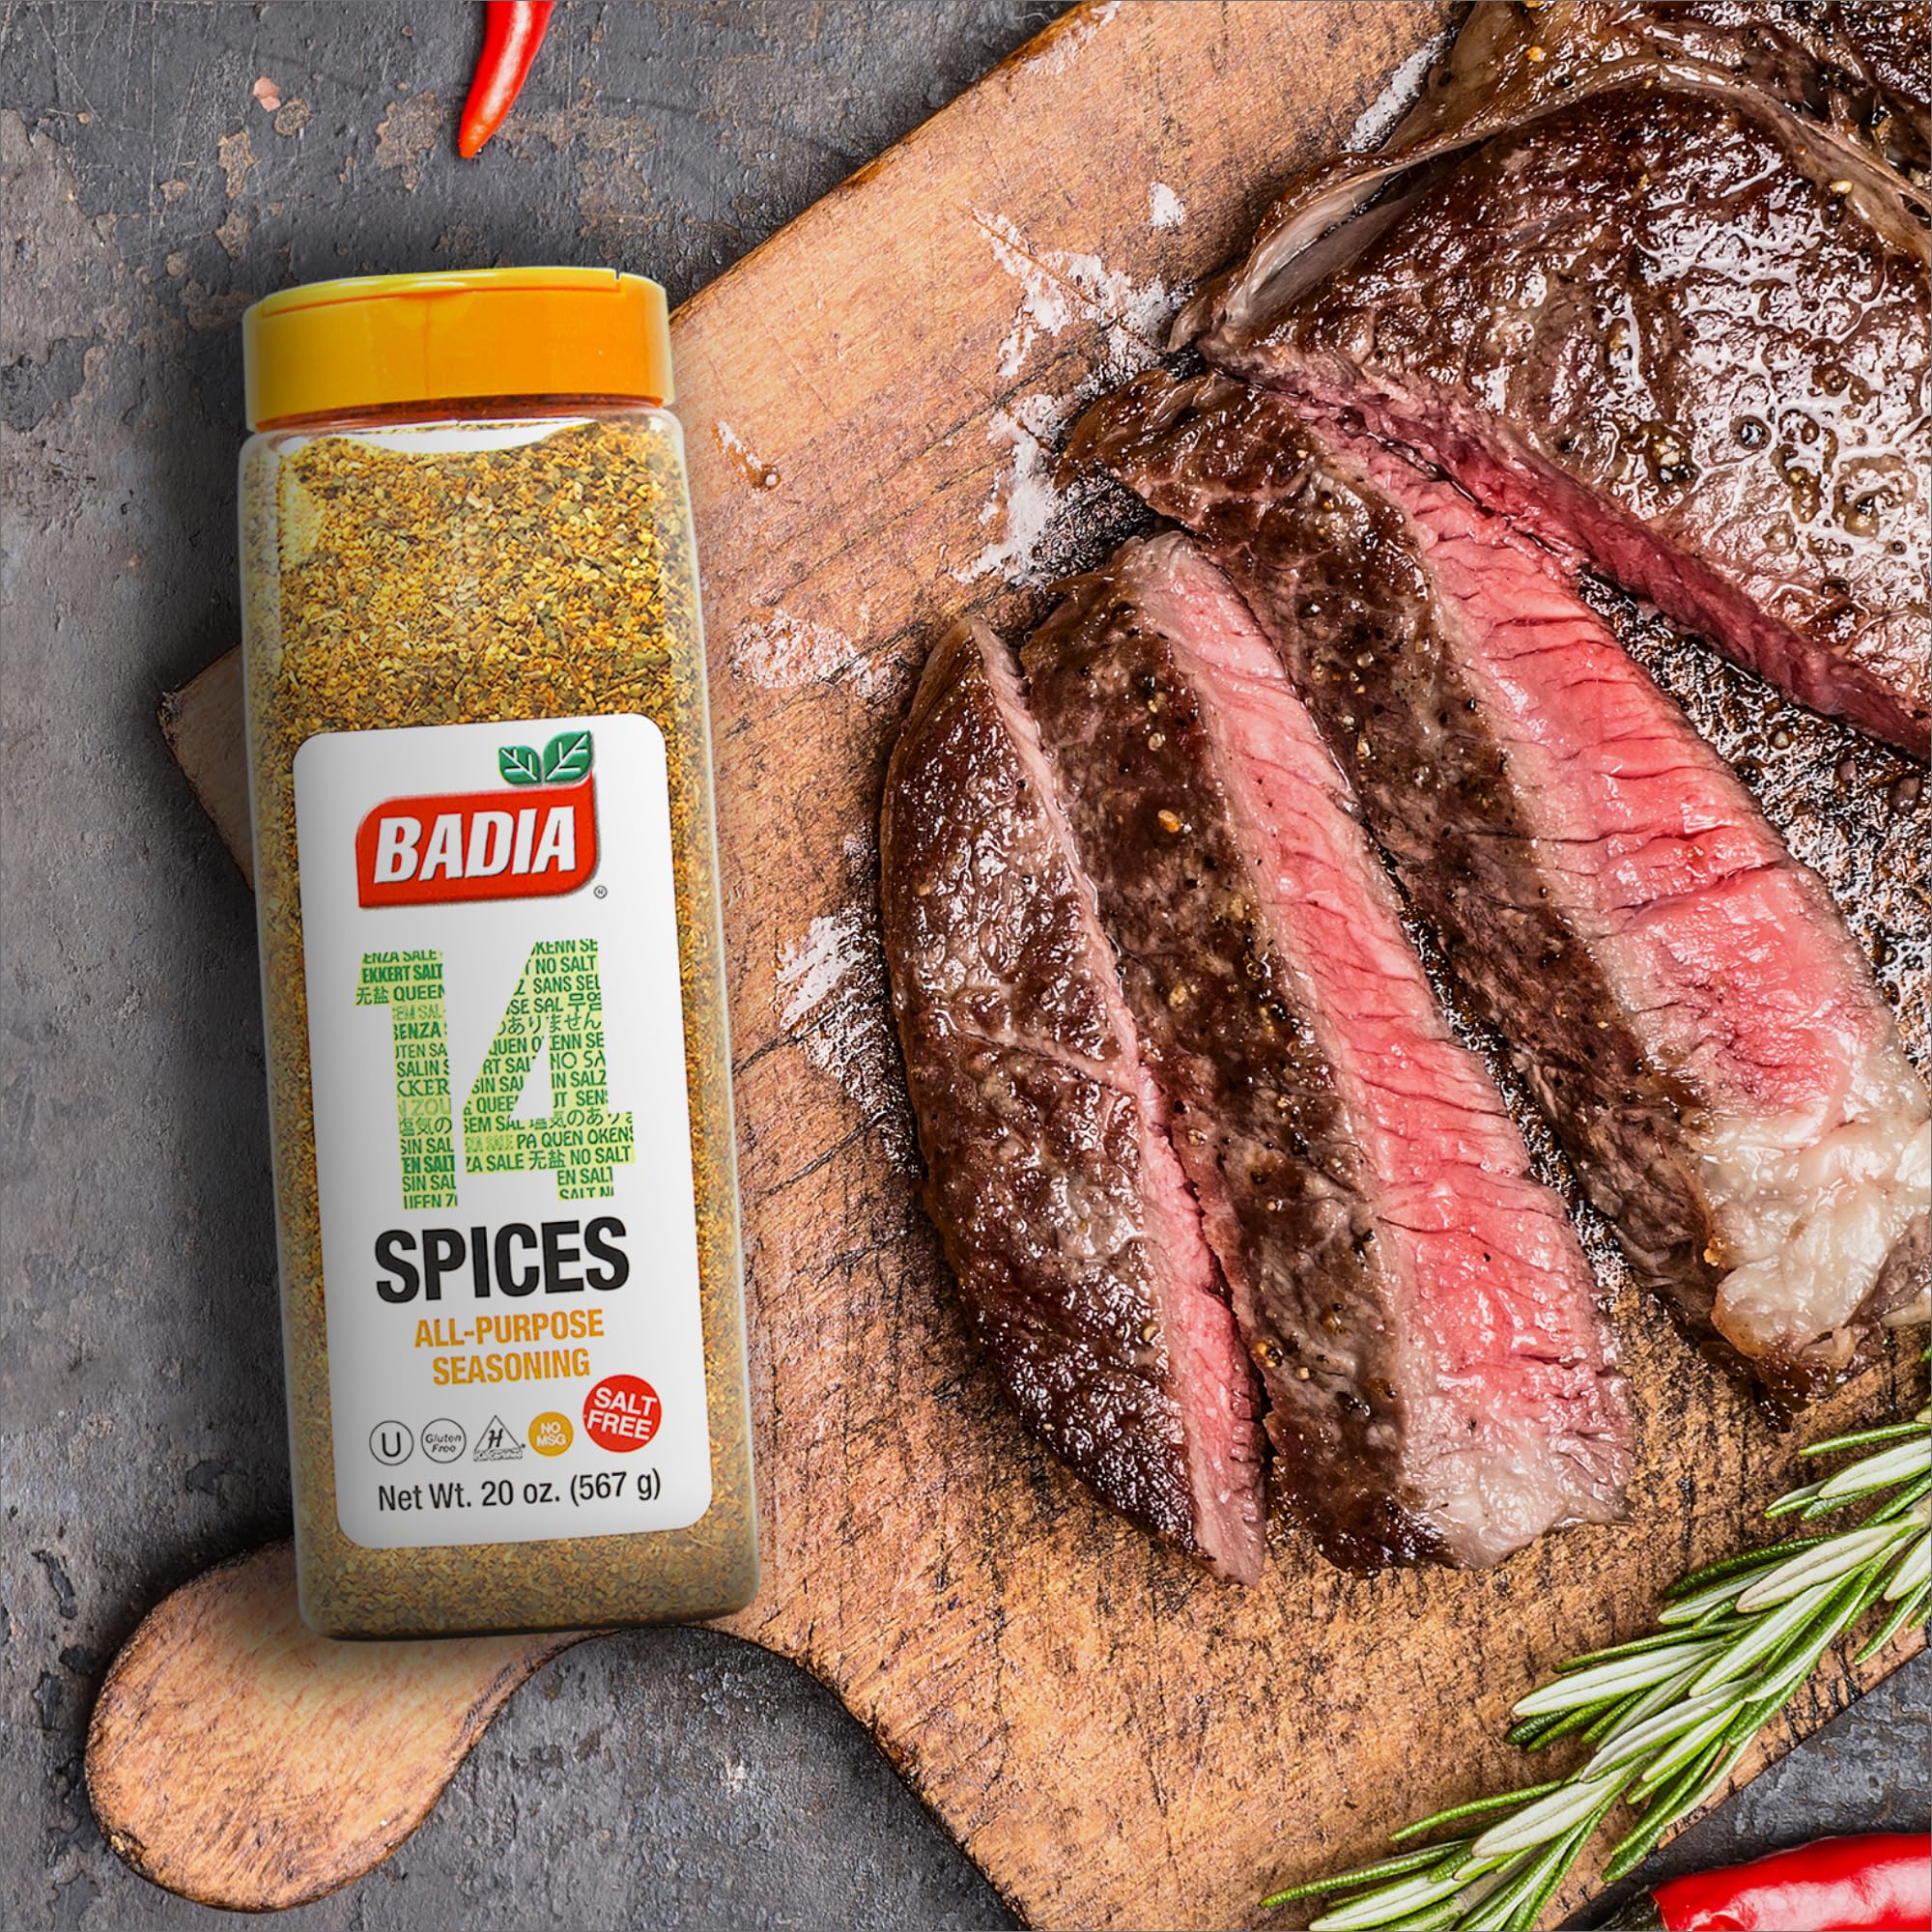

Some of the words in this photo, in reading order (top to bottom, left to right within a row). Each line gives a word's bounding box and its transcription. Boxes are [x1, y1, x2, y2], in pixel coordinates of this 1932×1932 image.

[374, 806, 576, 884] BADIA
[535, 957, 556, 974] NO
[560, 954, 596, 973] SALT
[532, 976, 572, 994] SANS
[397, 1061, 440, 1077] SALIN
[486, 1153, 525, 1172] SALE
[570, 1149, 591, 1165] NO
[595, 1145, 631, 1163] SALT
[402, 1176, 427, 1192] SIN
[375, 1216, 630, 1303] SPICES
[414, 1309, 604, 1349] ALL-PURPOSE
[432, 1348, 590, 1386] SEASONING
[593, 1386, 657, 1417] SALT
[541, 1421, 560, 1434] NO
[587, 1409, 652, 1440] FREE
[425, 1434, 462, 1443] Gluten
[432, 1443, 456, 1453] Free
[536, 1434, 566, 1446] MSG
[379, 1484, 422, 1511] Net
[430, 1482, 471, 1509] Wt.
[481, 1480, 514, 1506] 20
[524, 1483, 560, 1504] oz.
[571, 1471, 627, 1507] (567
[638, 1468, 661, 1500] g)
